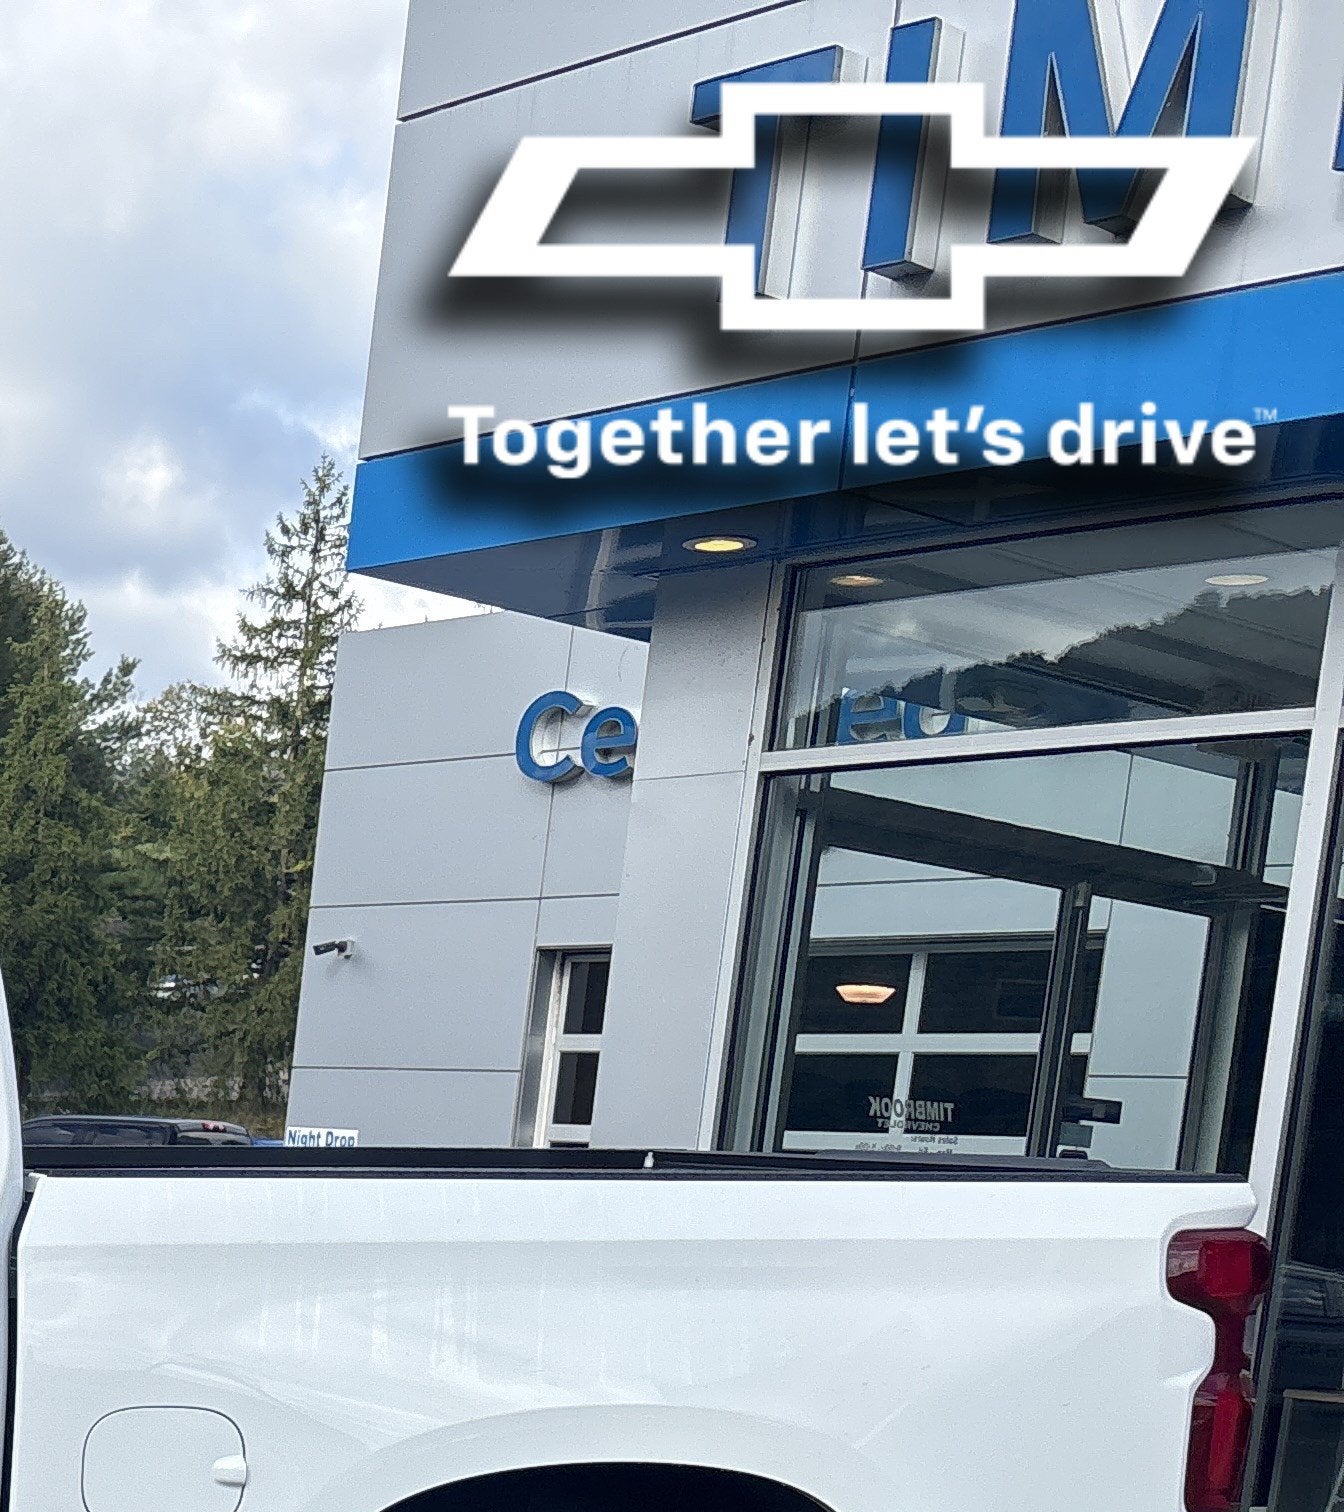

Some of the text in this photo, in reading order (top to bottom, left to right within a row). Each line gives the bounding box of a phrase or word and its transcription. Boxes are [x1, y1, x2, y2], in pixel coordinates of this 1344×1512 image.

[690, 0, 1344, 300] TIM
[288, 1129, 356, 1148] Night Drop
